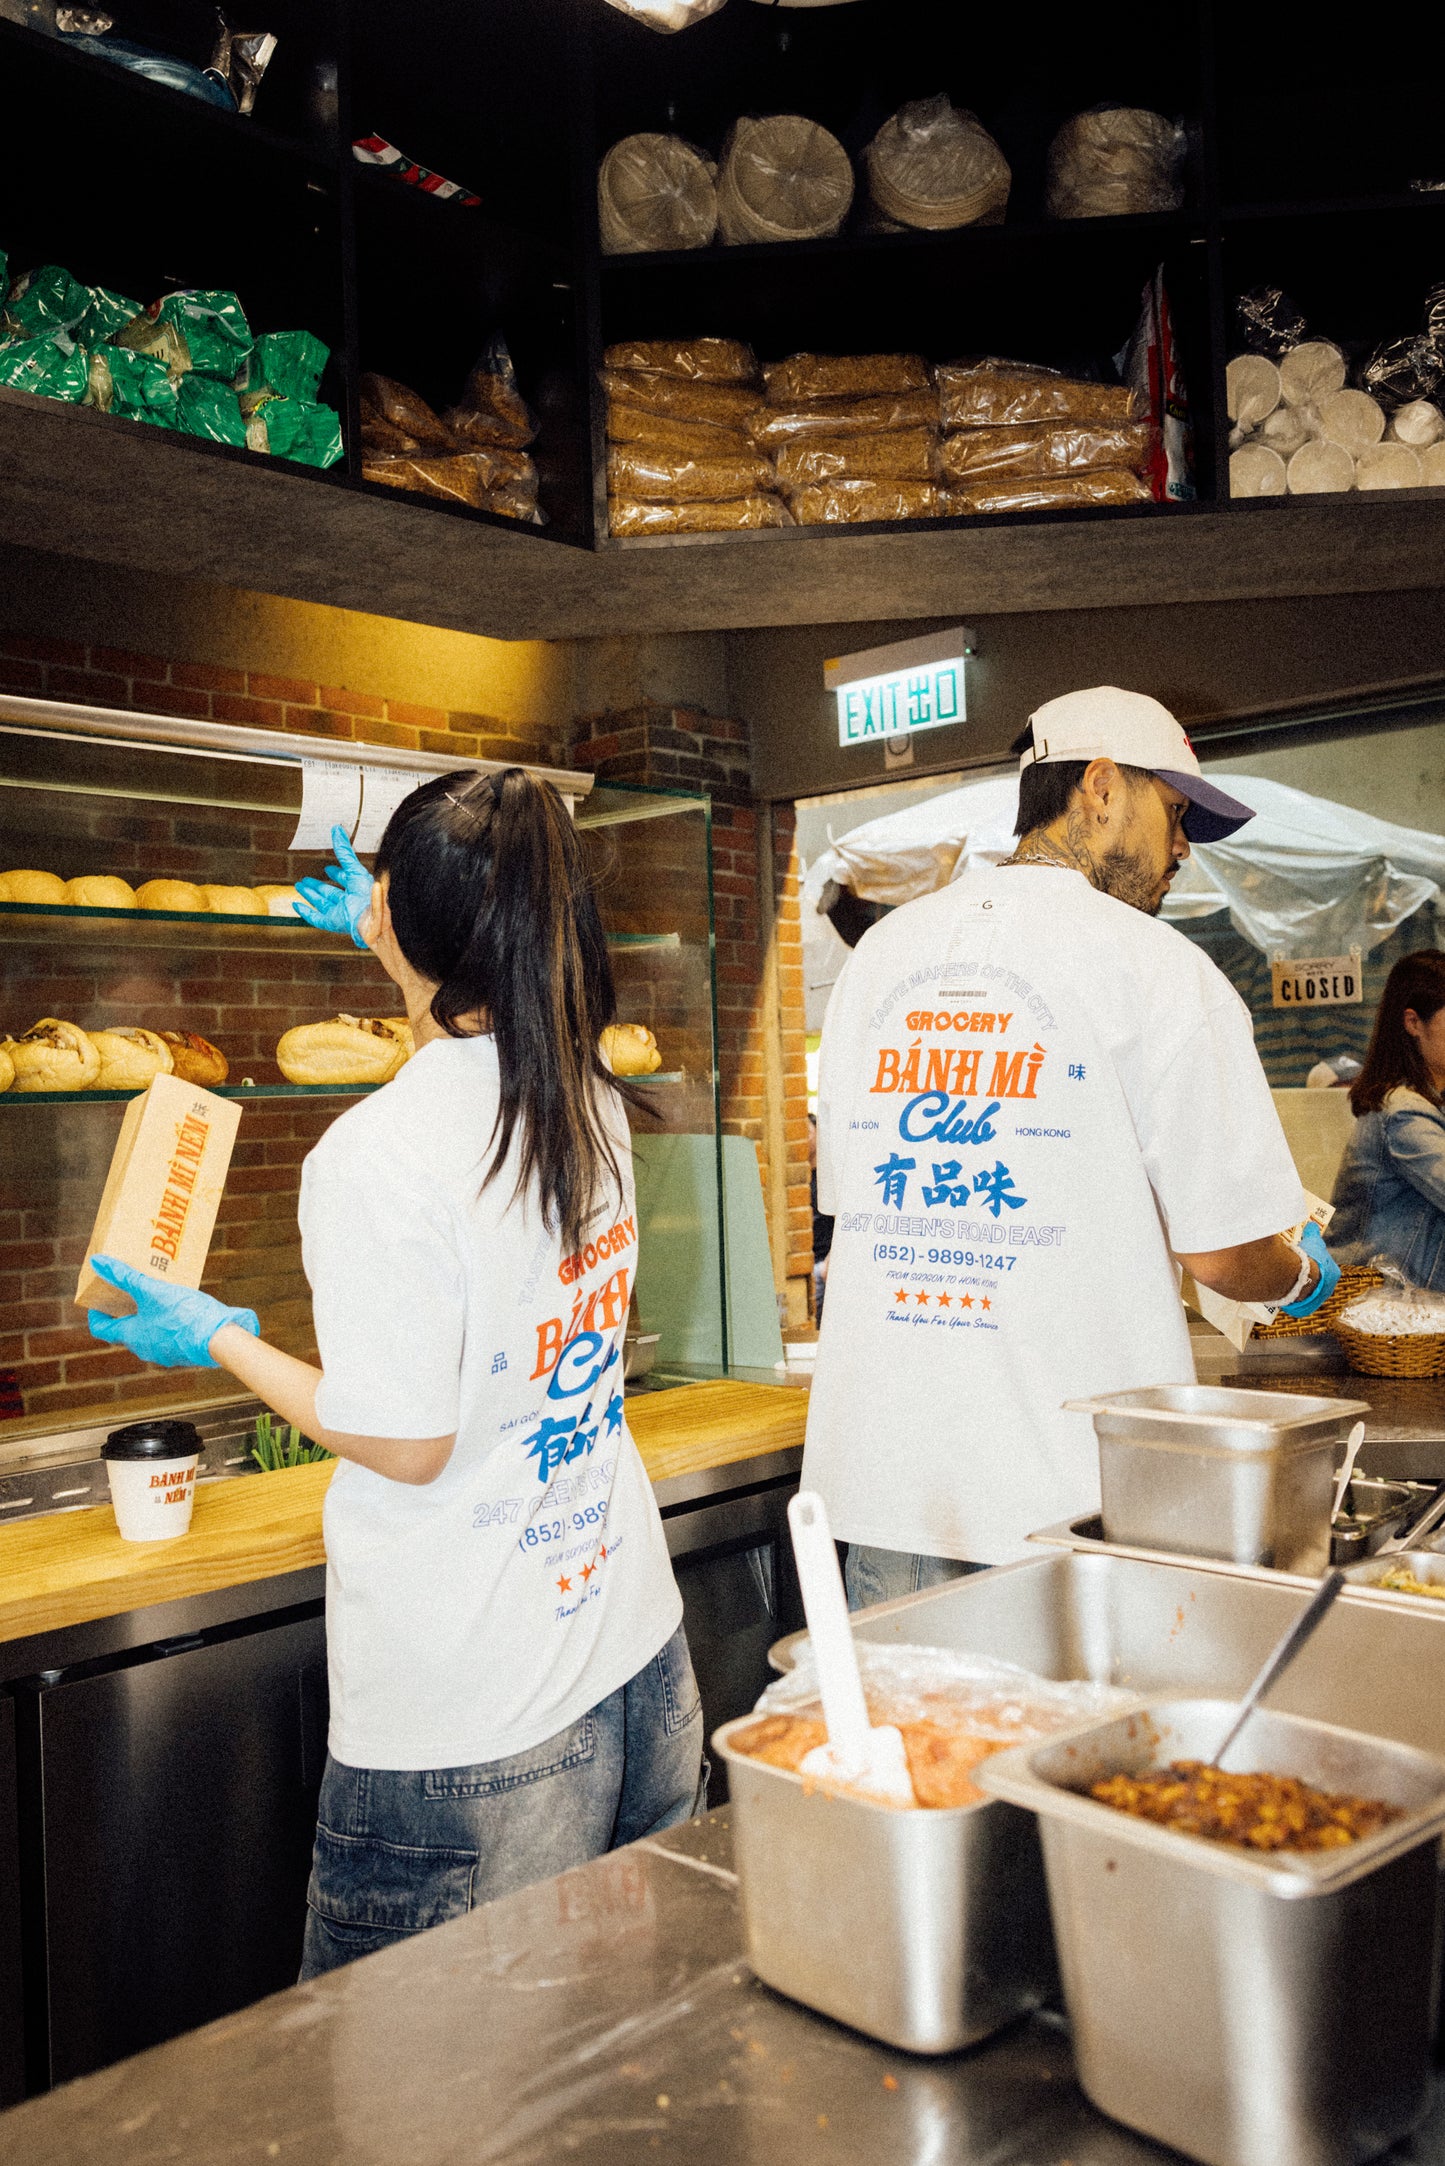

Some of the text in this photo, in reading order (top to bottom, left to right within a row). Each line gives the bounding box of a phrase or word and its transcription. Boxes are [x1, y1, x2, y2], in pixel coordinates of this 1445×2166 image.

[846, 668, 957, 738] EXIT 出口
[982, 900, 993, 910] G
[869, 962, 1060, 1032] TASTE MAKERS OF THE CITY
[1282, 975, 1354, 1001] CLOSED
[905, 1010, 1014, 1033] GROCERY
[869, 1036, 1048, 1099] BÁNH MÌ
[1068, 1064, 1086, 1081] 味
[898, 1090, 1001, 1145] Club
[1015, 1127, 1071, 1139] HONG KONG
[873, 1152, 1028, 1219] 有品味
[150, 1189, 190, 1261] BÁNH
[841, 1213, 1066, 1246] 247 QUEEN'S ROAD EAST
[150, 1255, 170, 1272] 品
[558, 1215, 636, 1286] GROCERY
[886, 1270, 909, 1281] FROM
[945, 1274, 957, 1284] TO
[958, 1276, 980, 1287] HONG
[885, 1310, 910, 1323] Thank
[912, 1313, 928, 1326] You
[931, 1314, 947, 1326] For
[949, 1316, 970, 1330] Your
[491, 1351, 508, 1375] 品
[472, 1498, 524, 1528] 247
